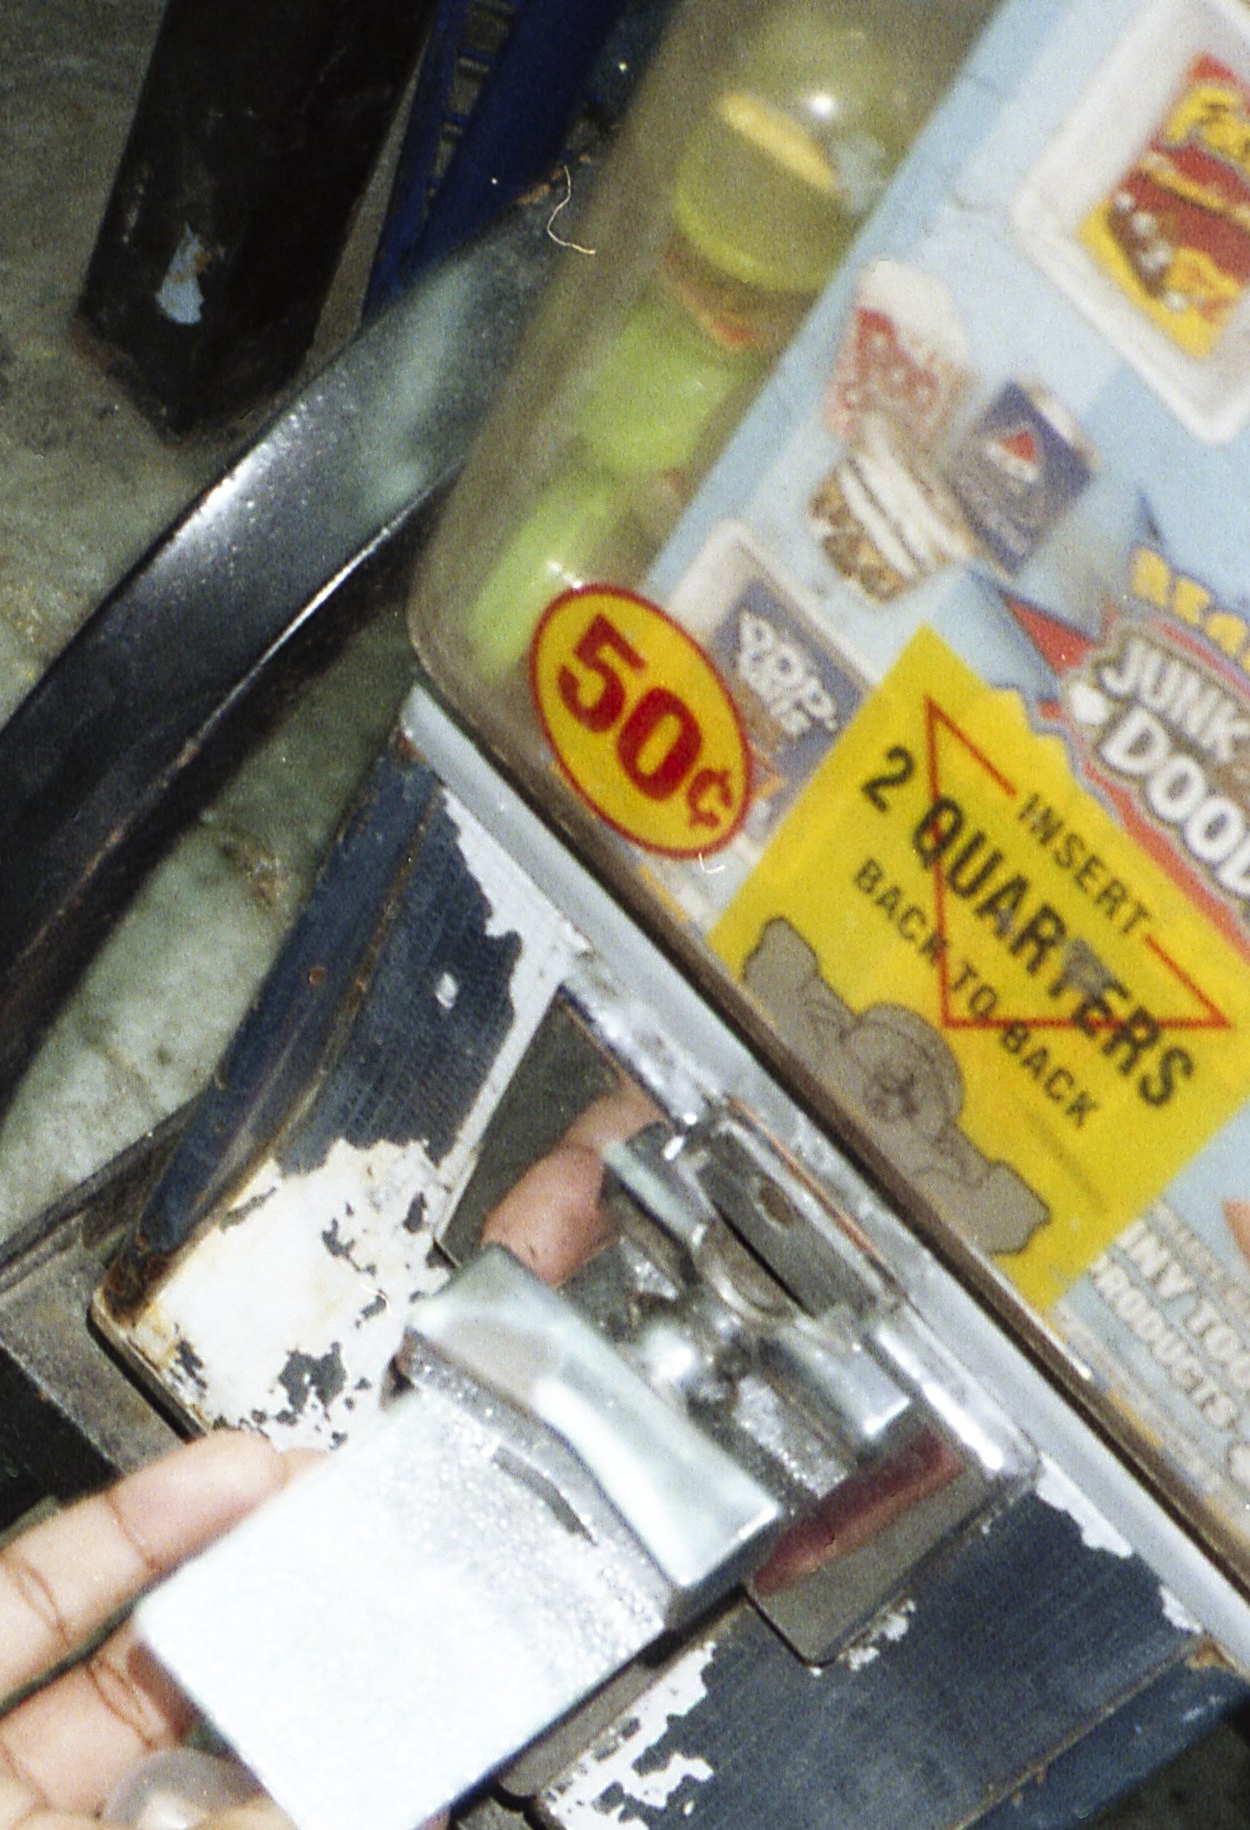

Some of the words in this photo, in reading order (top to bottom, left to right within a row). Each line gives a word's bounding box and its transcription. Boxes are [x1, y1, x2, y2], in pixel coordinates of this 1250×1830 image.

[557, 613, 733, 830] 50¢
[1101, 637, 1250, 762] JUNK
[861, 745, 915, 813] 2
[912, 797, 1195, 1107] QUARTERS
[1017, 794, 1152, 936] INSERT
[854, 857, 948, 968] BACK
[950, 958, 999, 1020] TO
[1000, 1019, 1100, 1128] BACK
